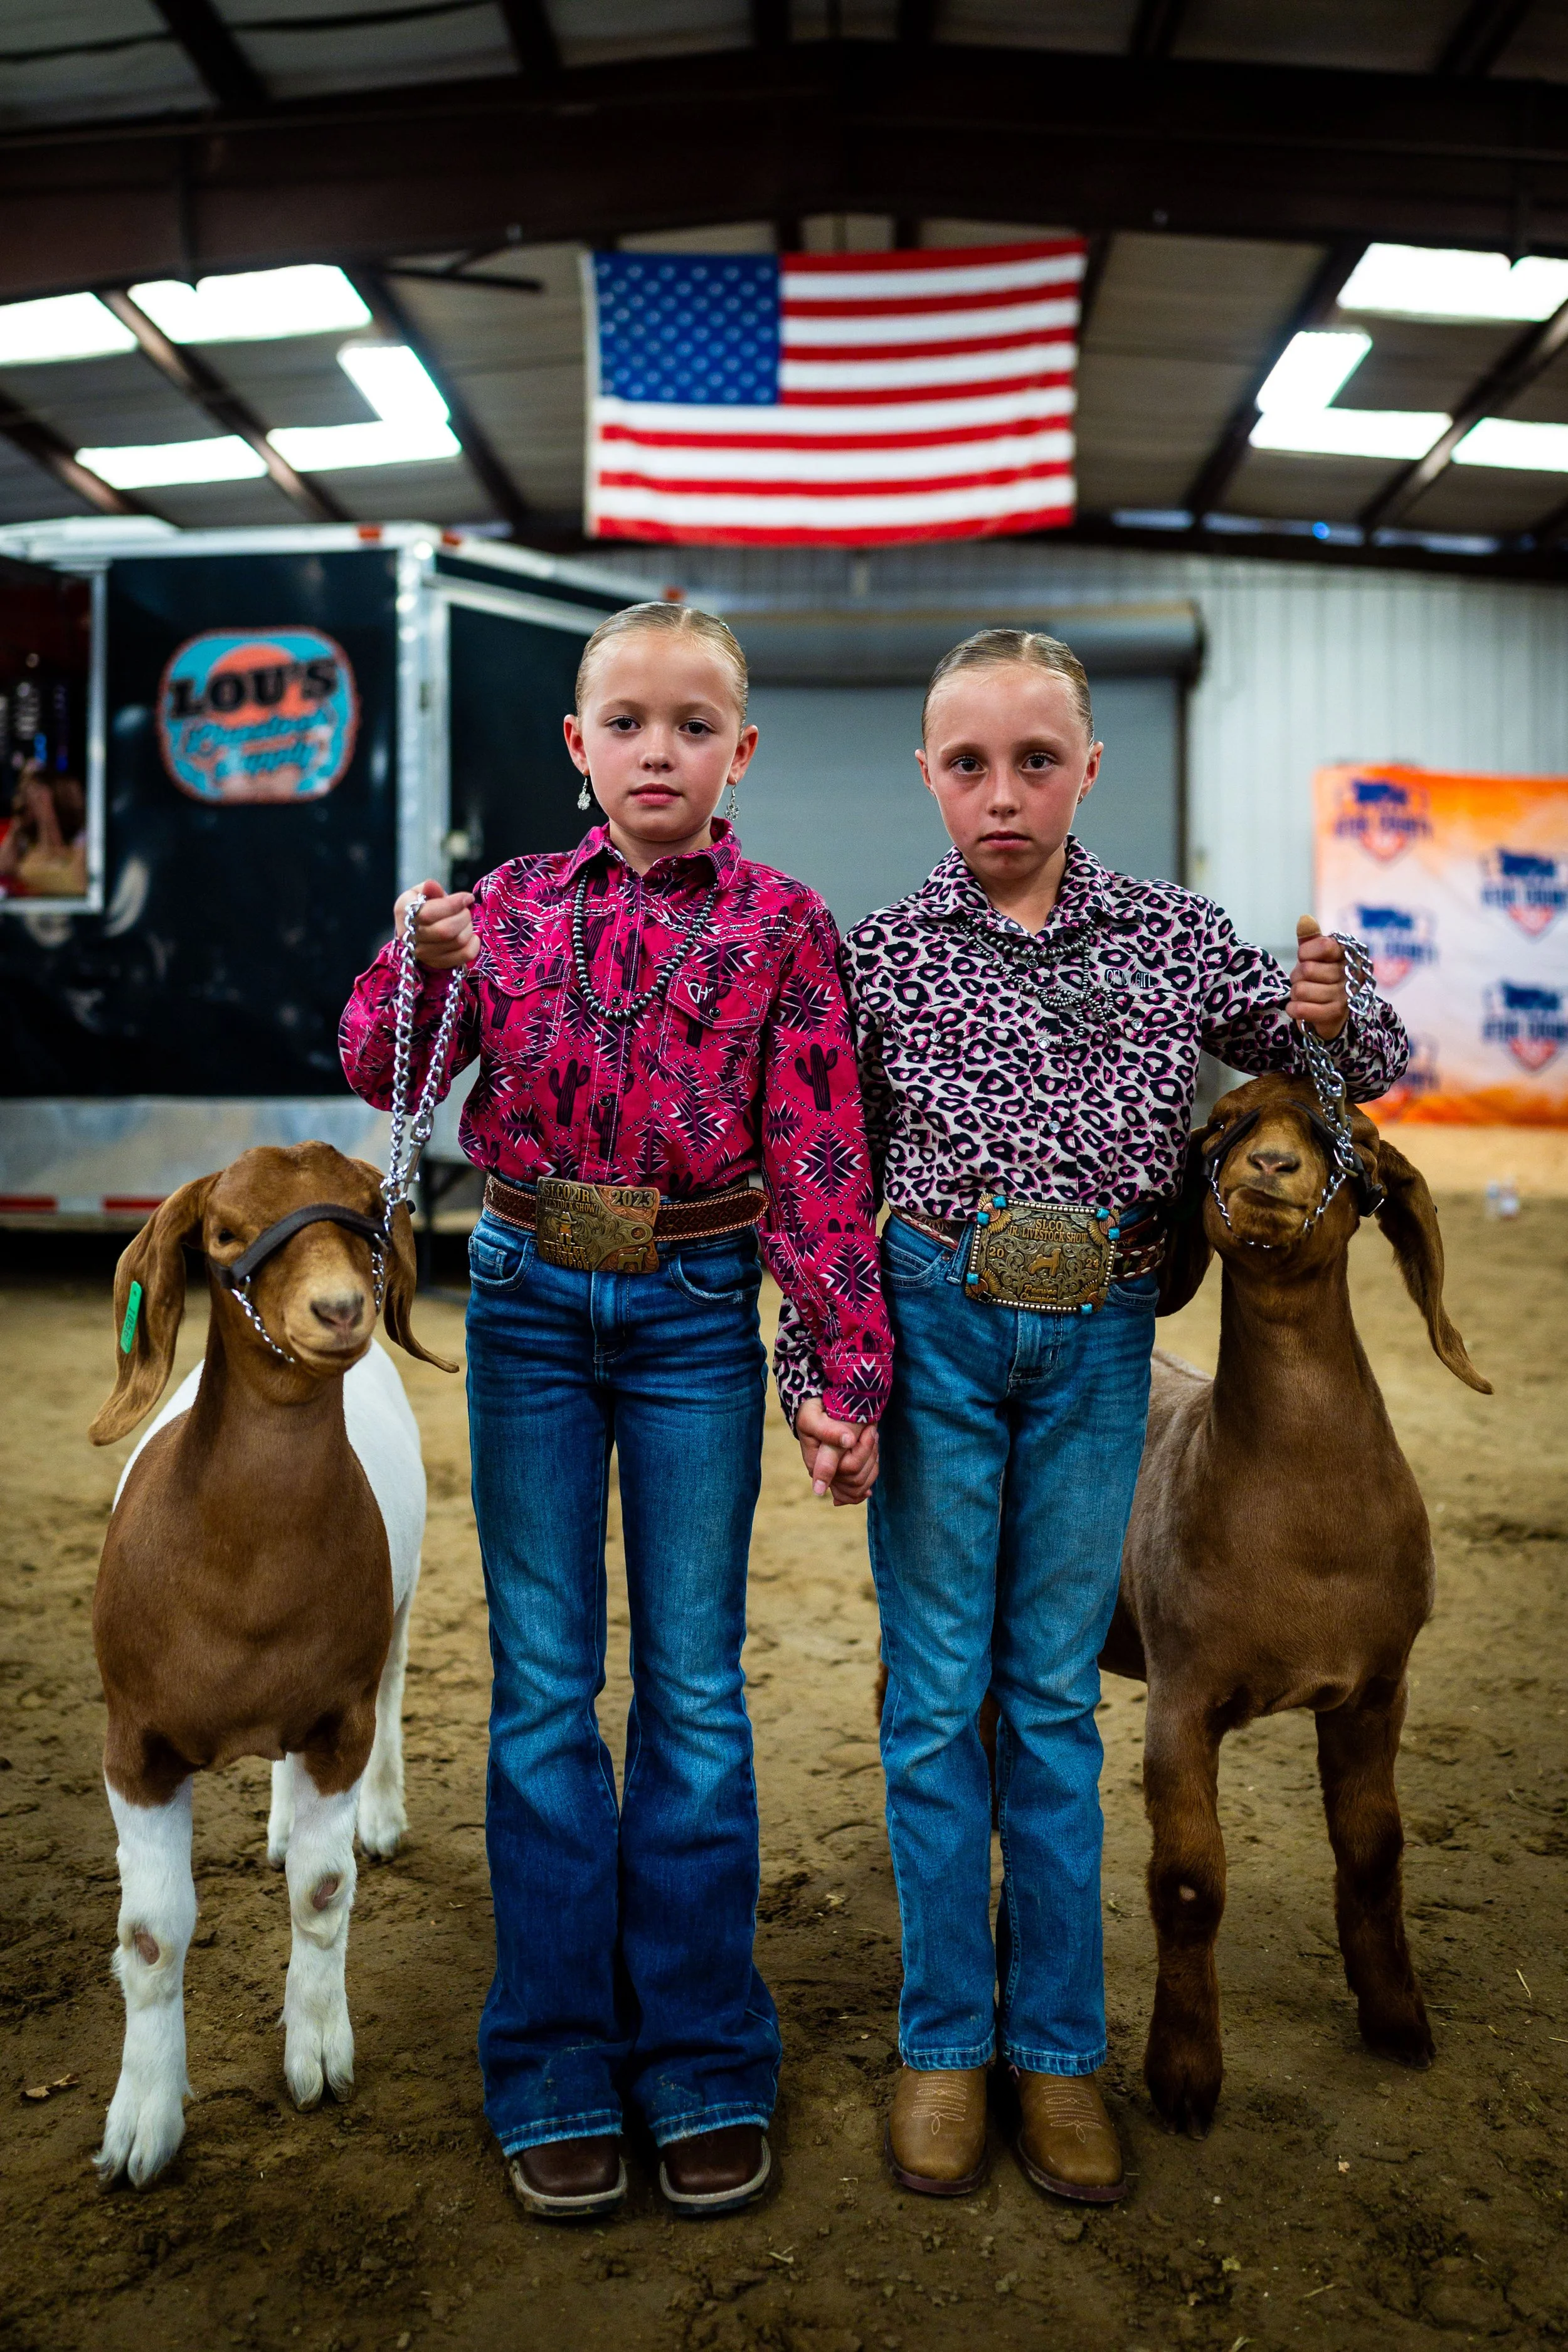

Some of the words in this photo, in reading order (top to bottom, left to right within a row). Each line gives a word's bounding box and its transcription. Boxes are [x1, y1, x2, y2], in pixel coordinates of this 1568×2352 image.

[169, 657, 337, 719] LOU'S
[544, 1184, 570, 1200] SLCO
[611, 1189, 655, 1208] 2023
[538, 1195, 575, 1211] LIVESTOCK
[576, 1202, 596, 1214] SHOW
[1035, 1219, 1064, 1231] SLCO
[1022, 1227, 1065, 1242] LIVESTOCK
[1066, 1231, 1089, 1243] SHOW
[989, 1246, 1004, 1258] 20
[545, 1254, 590, 1271] CHAMPION
[1086, 1258, 1099, 1268] 24
[1020, 1292, 1058, 1303] Champion
[1024, 1284, 1057, 1295] Peewee
